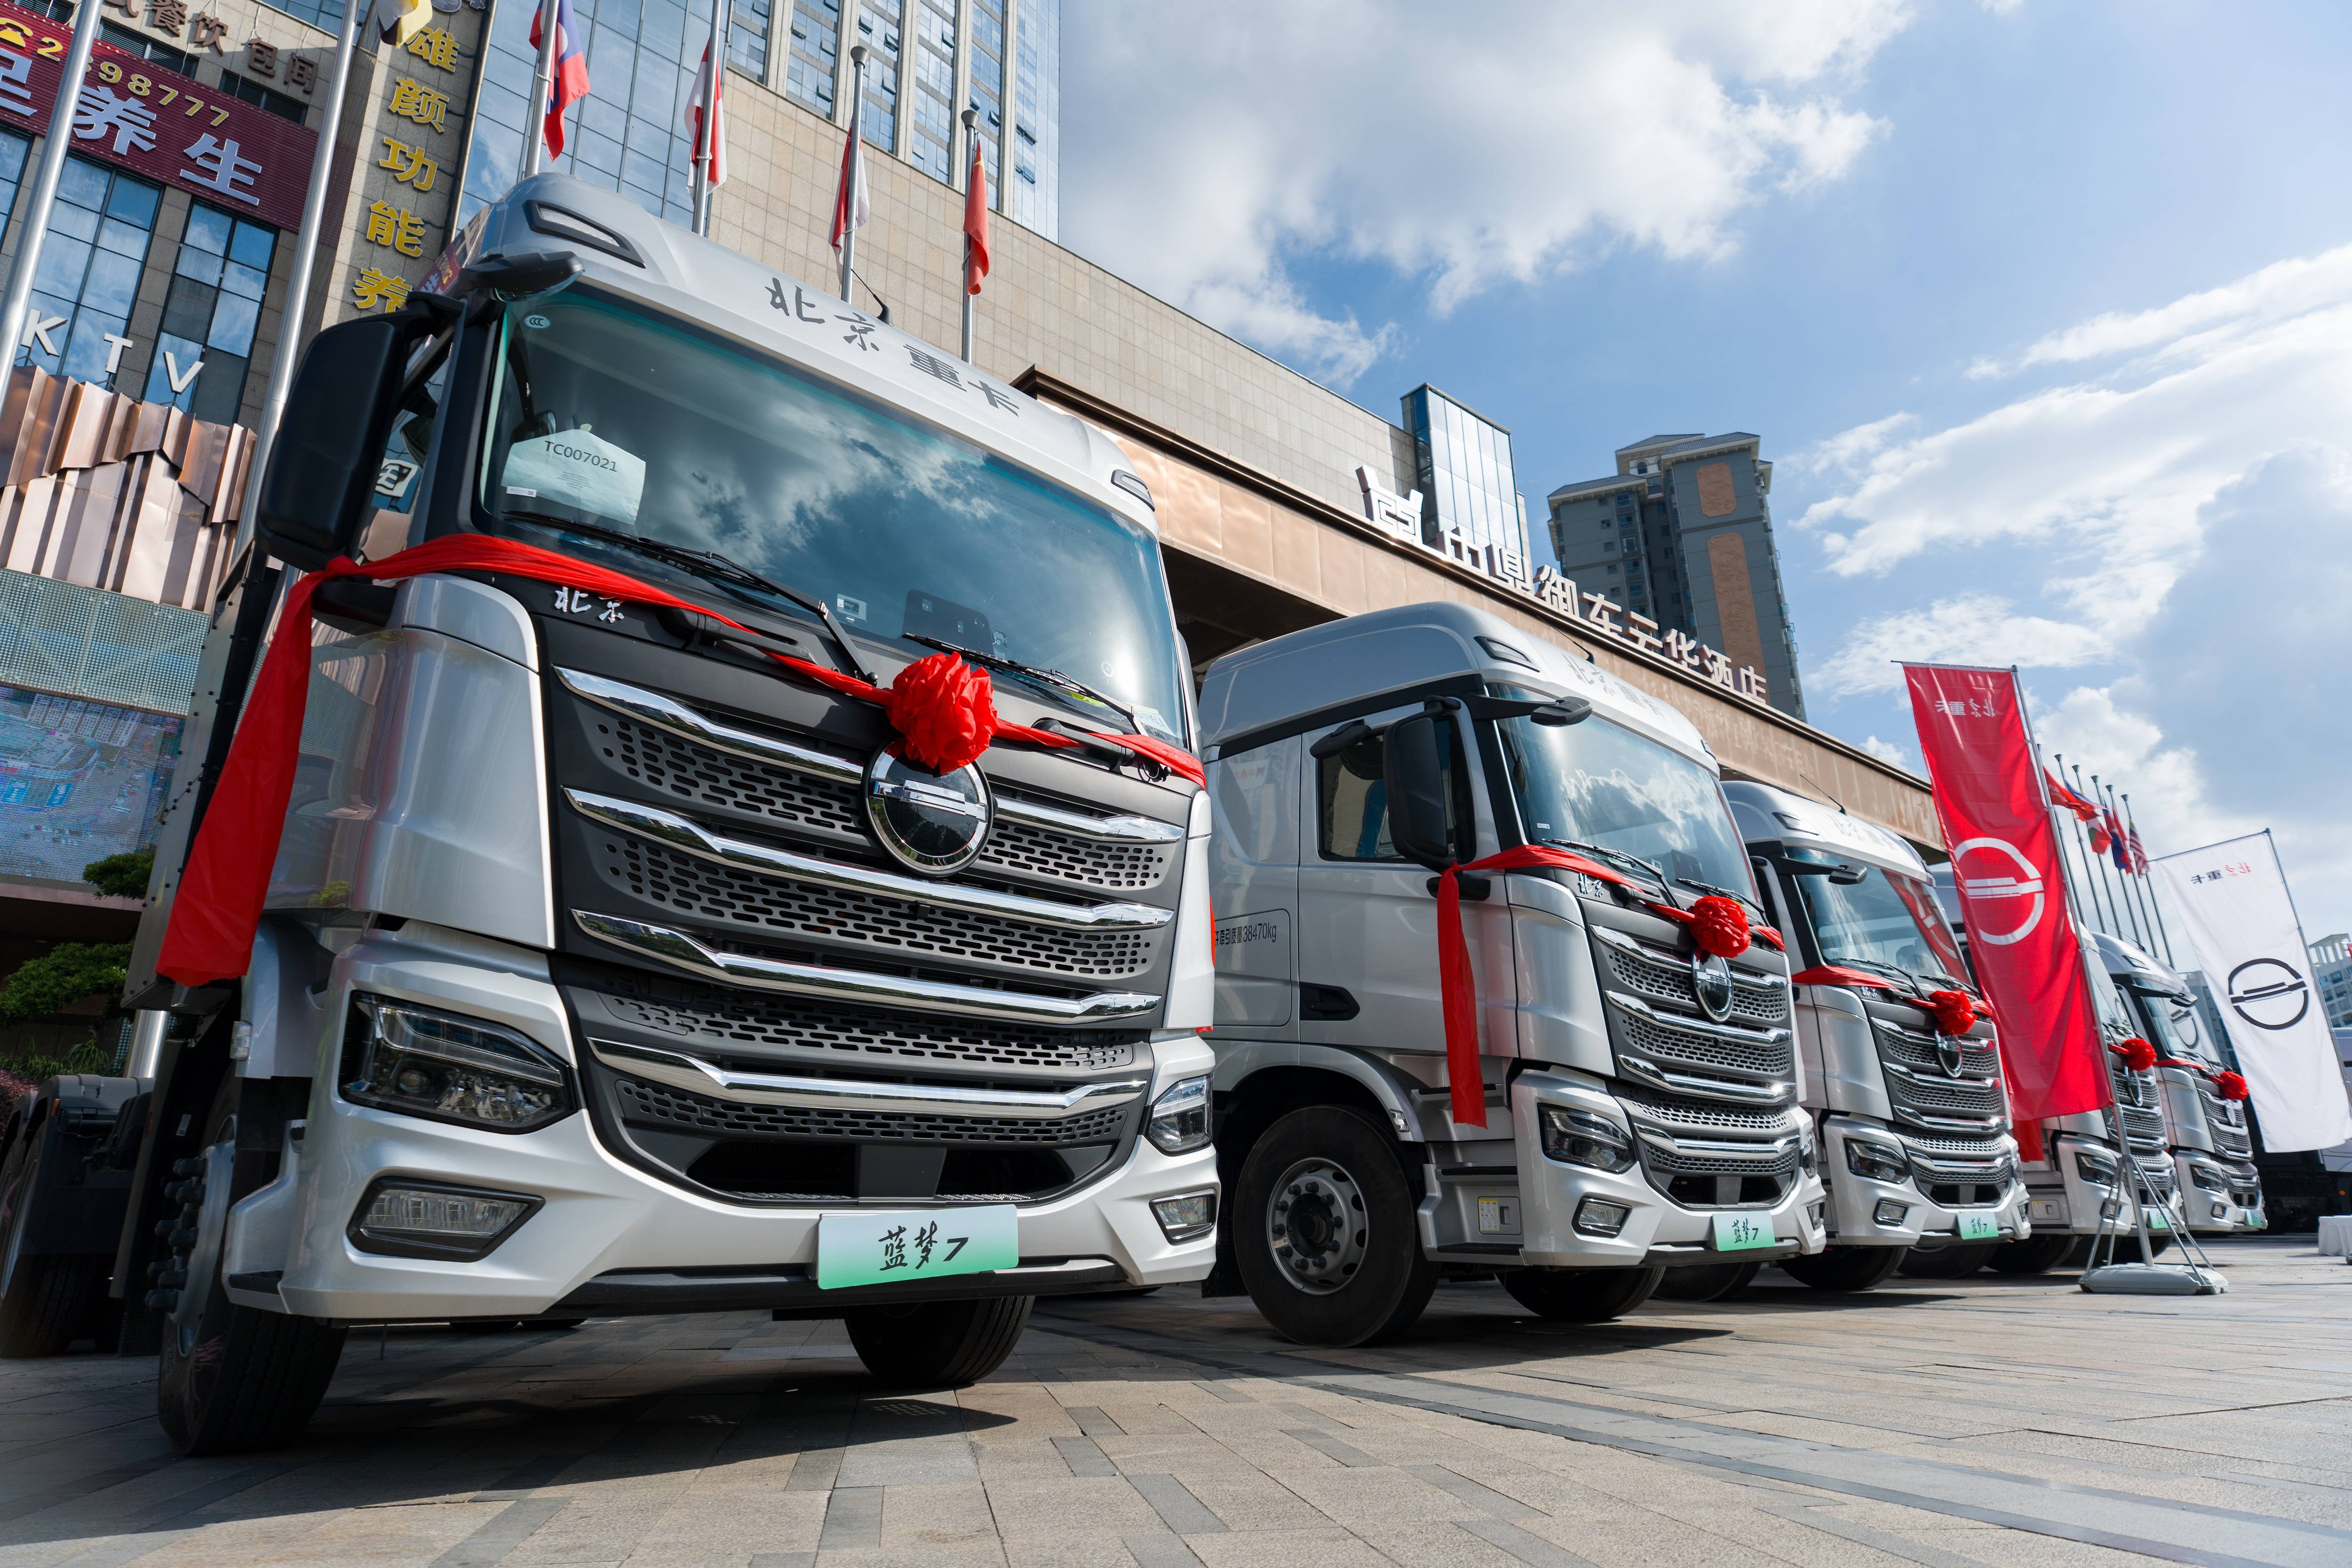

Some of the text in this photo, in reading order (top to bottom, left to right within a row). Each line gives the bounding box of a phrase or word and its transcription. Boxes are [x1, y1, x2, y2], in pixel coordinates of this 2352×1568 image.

[102, 0, 318, 93] 餐饮包间
[21, 308, 205, 394] KTV
[765, 277, 1020, 417] 北京重卡
[544, 440, 617, 472] TC007021
[878, 1220, 969, 1271] 蓝梦7
